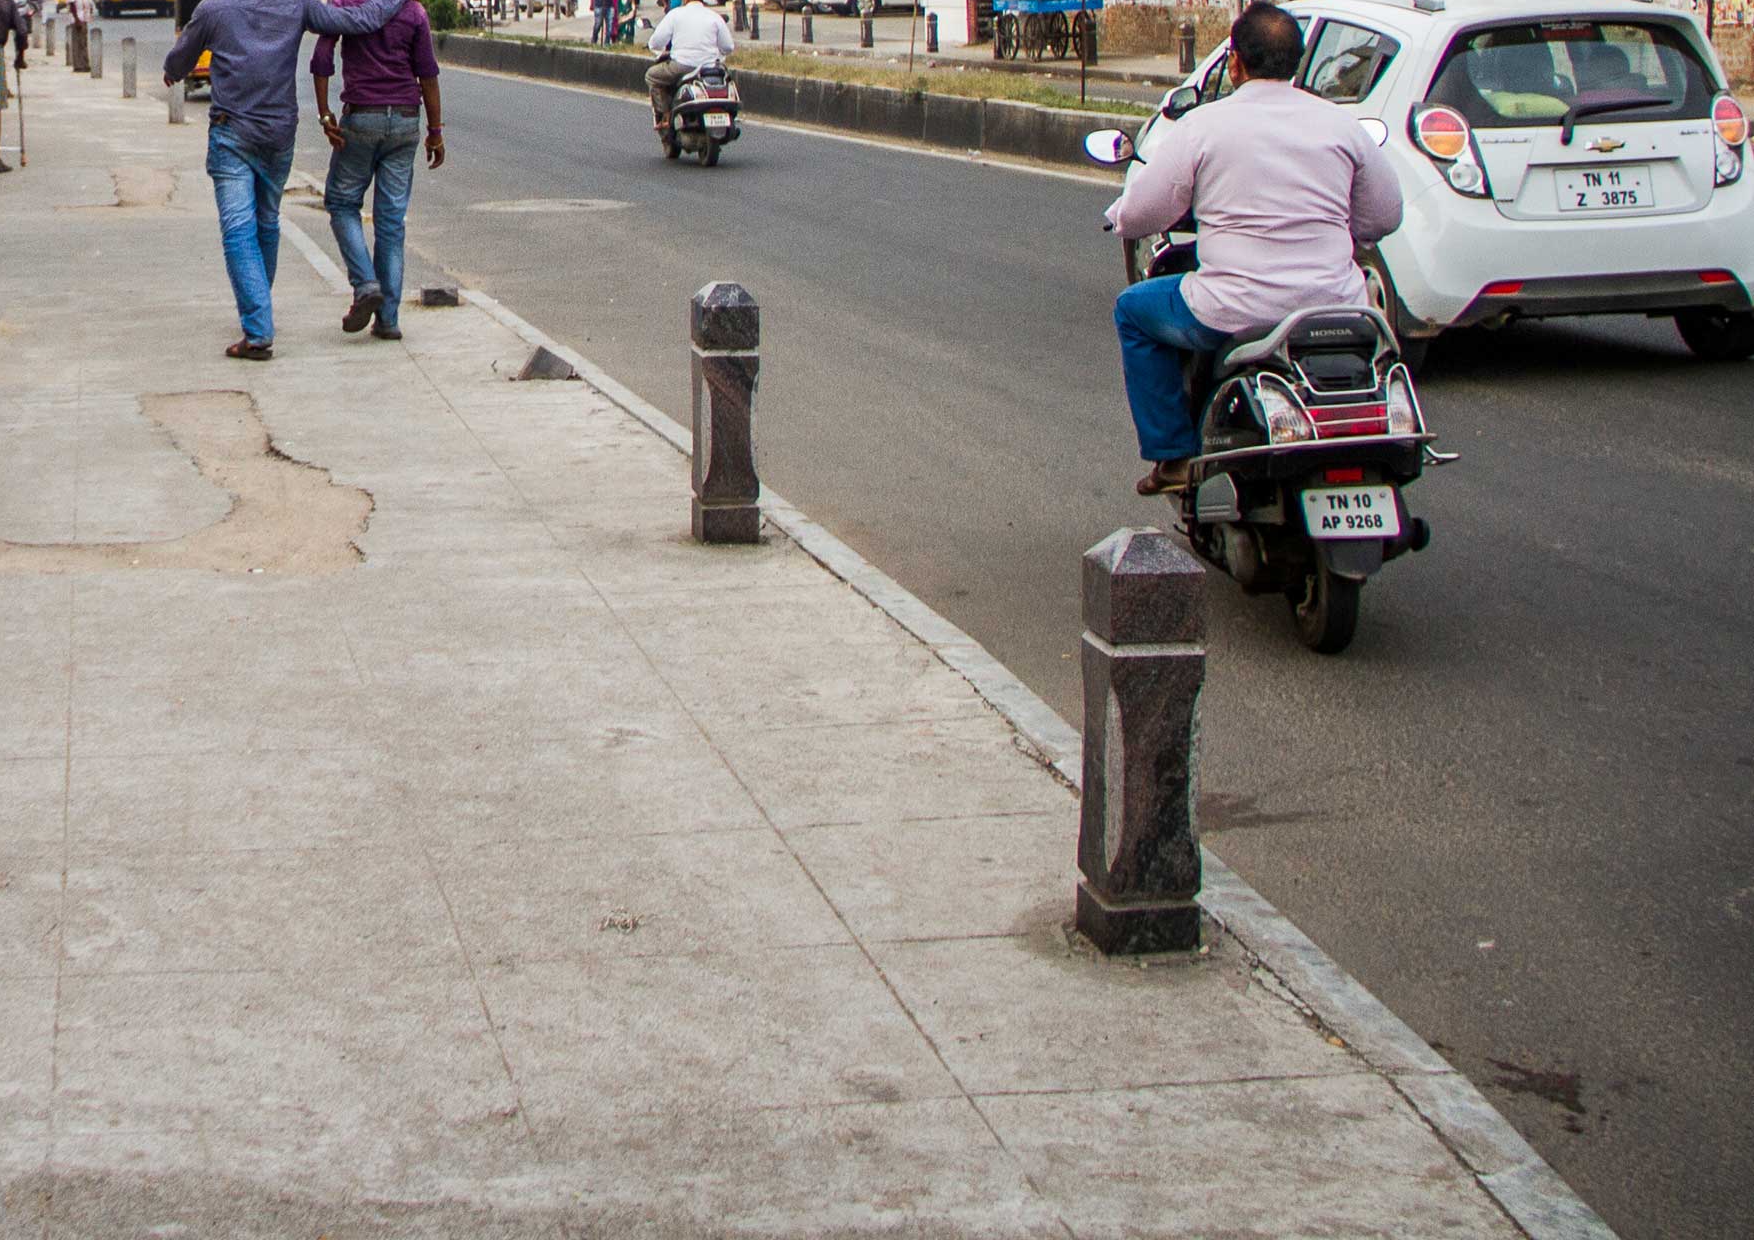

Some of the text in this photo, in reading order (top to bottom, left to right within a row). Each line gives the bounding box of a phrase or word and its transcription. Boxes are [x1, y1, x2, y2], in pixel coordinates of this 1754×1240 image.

[1582, 171, 1621, 187] TN 11
[1576, 190, 1638, 207] Z 3875
[1309, 327, 1353, 338] HONDA
[1326, 493, 1371, 510] TN 10
[1321, 514, 1383, 530] AP 9268
